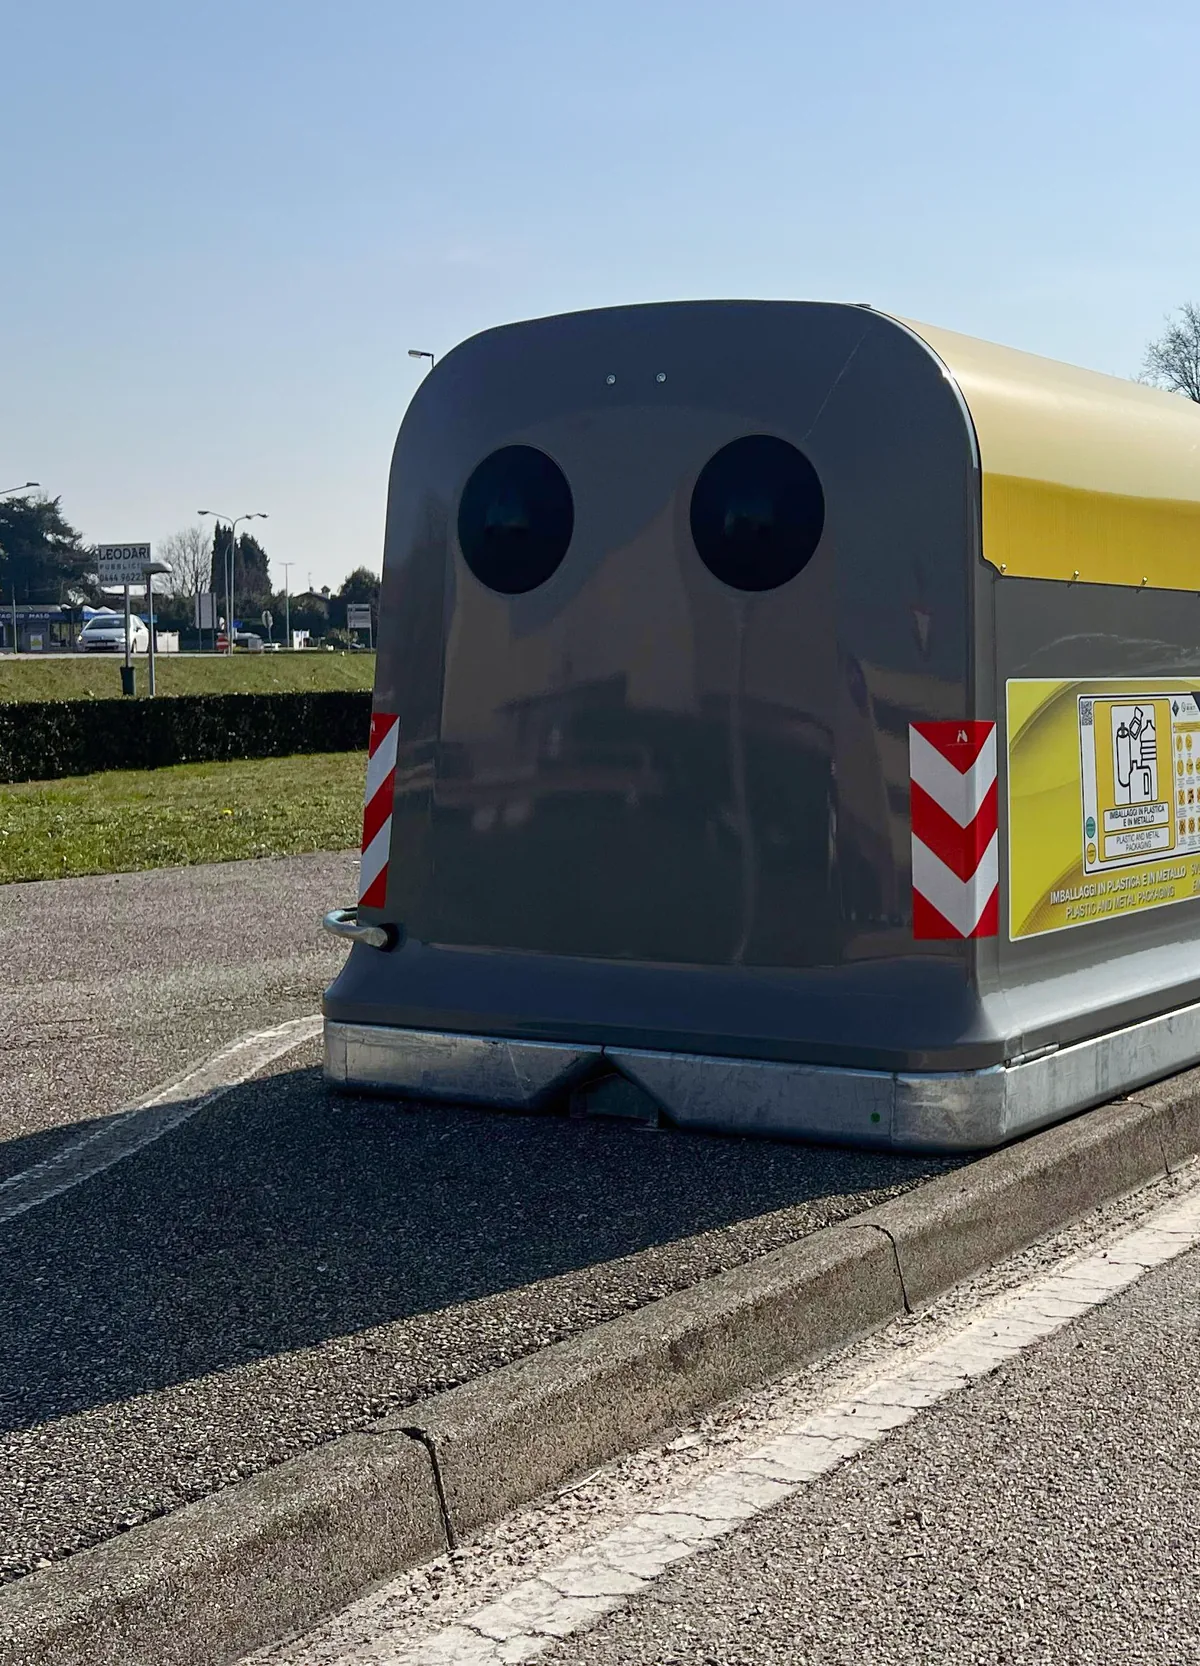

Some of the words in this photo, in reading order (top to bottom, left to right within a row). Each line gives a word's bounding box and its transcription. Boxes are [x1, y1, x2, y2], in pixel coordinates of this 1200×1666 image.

[99, 547, 150, 560] LEODARI
[100, 562, 142, 570] PUBBLICI
[1109, 808, 1138, 820] IMBALLAGGI
[1138, 808, 1144, 816] IN
[1144, 804, 1165, 815] PLASTICA
[1123, 818, 1127, 827] E
[1128, 818, 1133, 826] IN
[1133, 814, 1155, 825] METALLO
[1116, 833, 1135, 845] PLASTIC
[1135, 832, 1145, 842] AND
[1145, 830, 1160, 840] METAL
[1125, 840, 1152, 852] PACKAGING
[1050, 883, 1097, 905] IMBALLAGGI
[1098, 881, 1106, 895] IN
[1107, 875, 1141, 892] PLASTICA
[1142, 873, 1148, 886] E
[1149, 871, 1156, 885] IN
[1157, 864, 1187, 883] METALLO
[1066, 901, 1097, 919] PLASTIC
[1098, 898, 1114, 913] AND
[1114, 893, 1137, 910] METAL
[1137, 885, 1175, 904] PACKAGING
